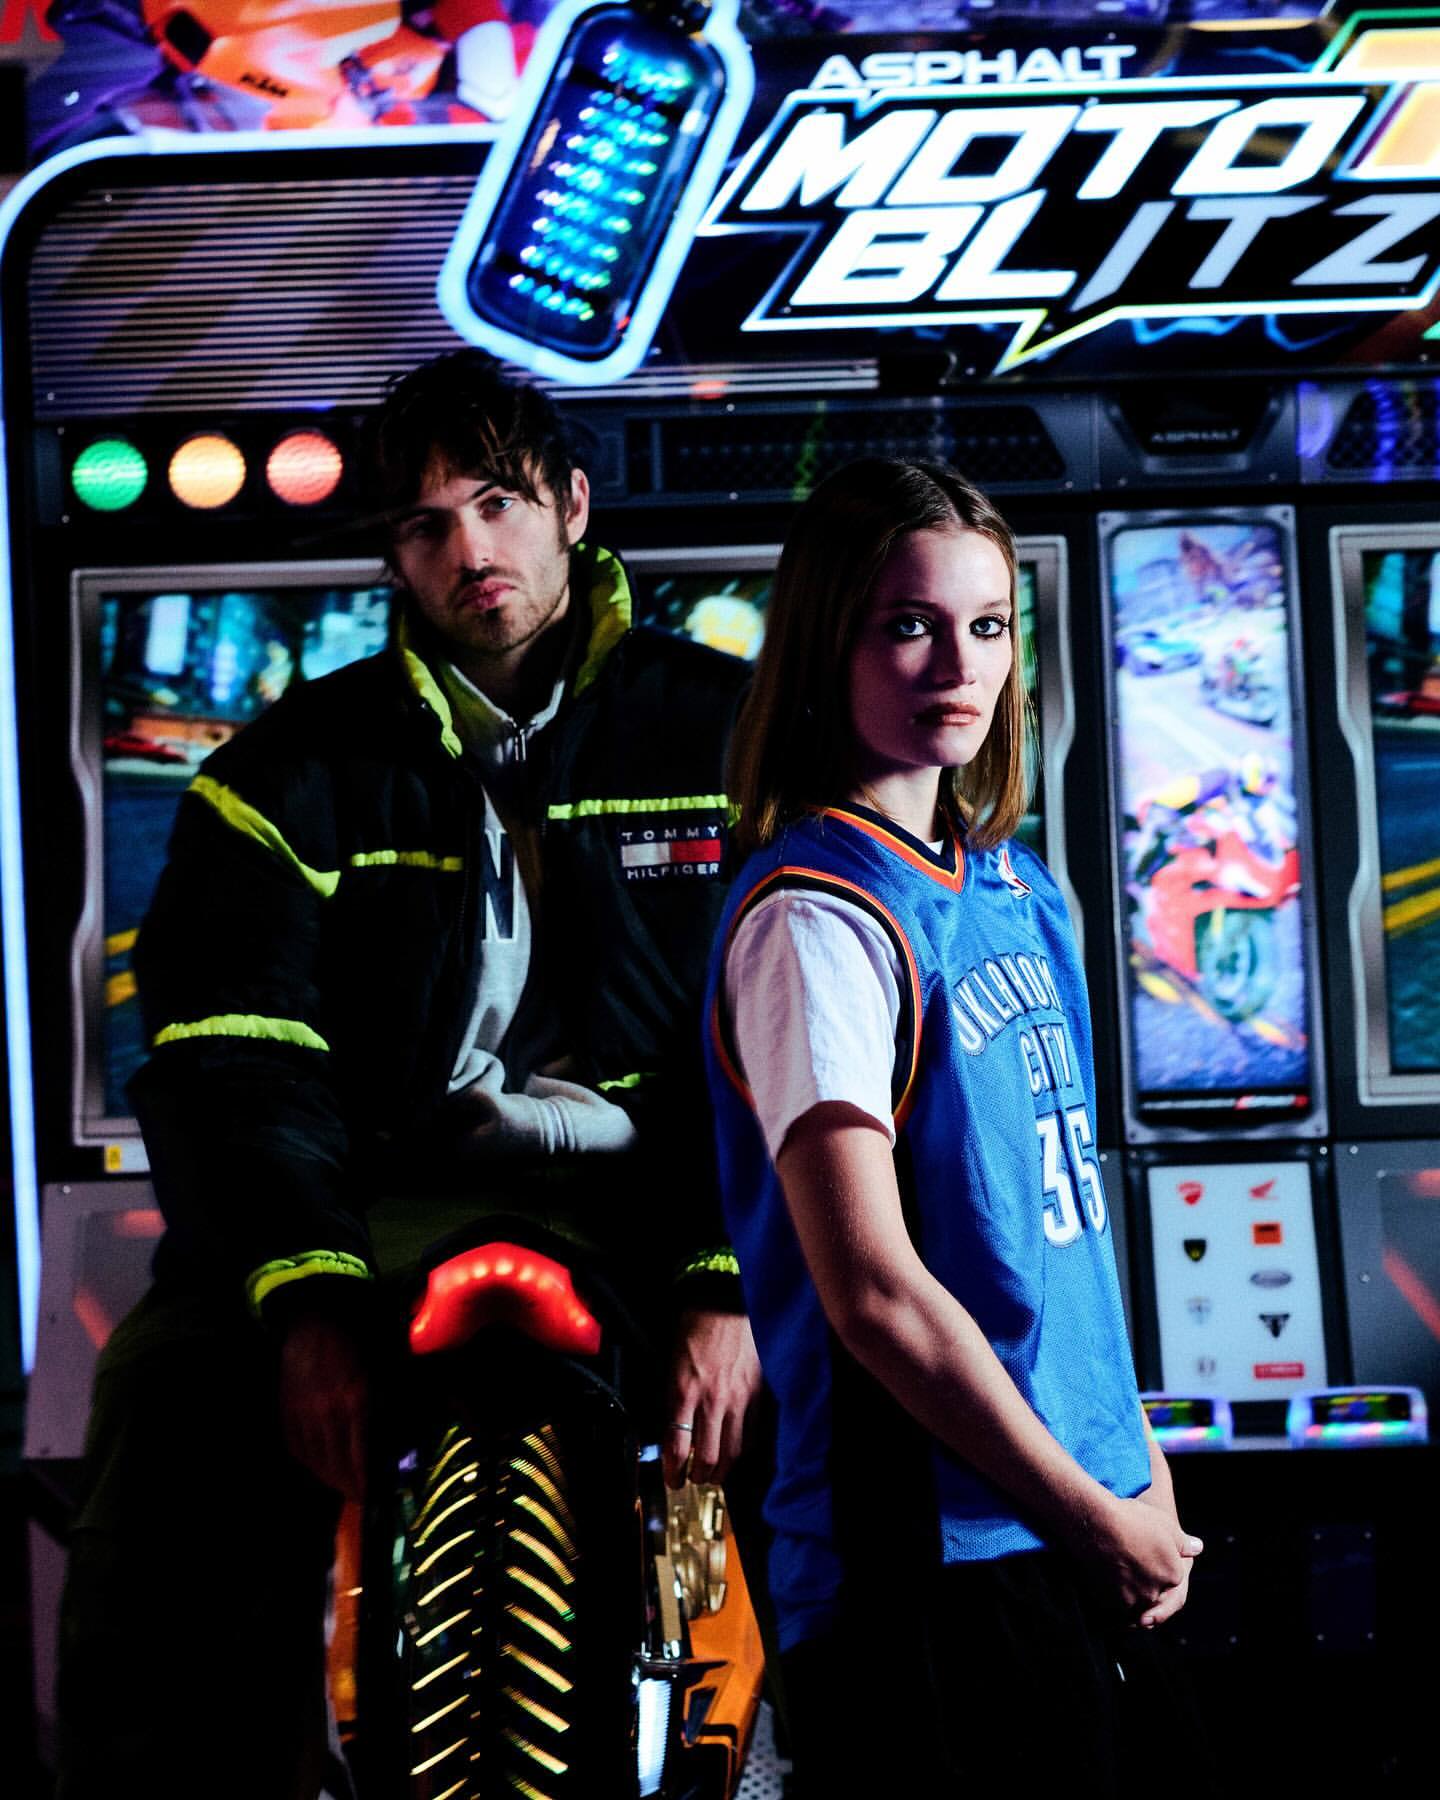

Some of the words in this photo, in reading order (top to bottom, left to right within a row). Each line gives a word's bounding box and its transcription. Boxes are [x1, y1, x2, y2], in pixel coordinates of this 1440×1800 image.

[809, 44, 1137, 90] ASPHALT
[740, 96, 1367, 211] MOTO
[788, 188, 1440, 313] BLITZ
[621, 825, 718, 842] TOMMY
[626, 862, 720, 880] HILFIGER
[1018, 1020, 1074, 1097] CITY
[1035, 1102, 1108, 1249] 35
